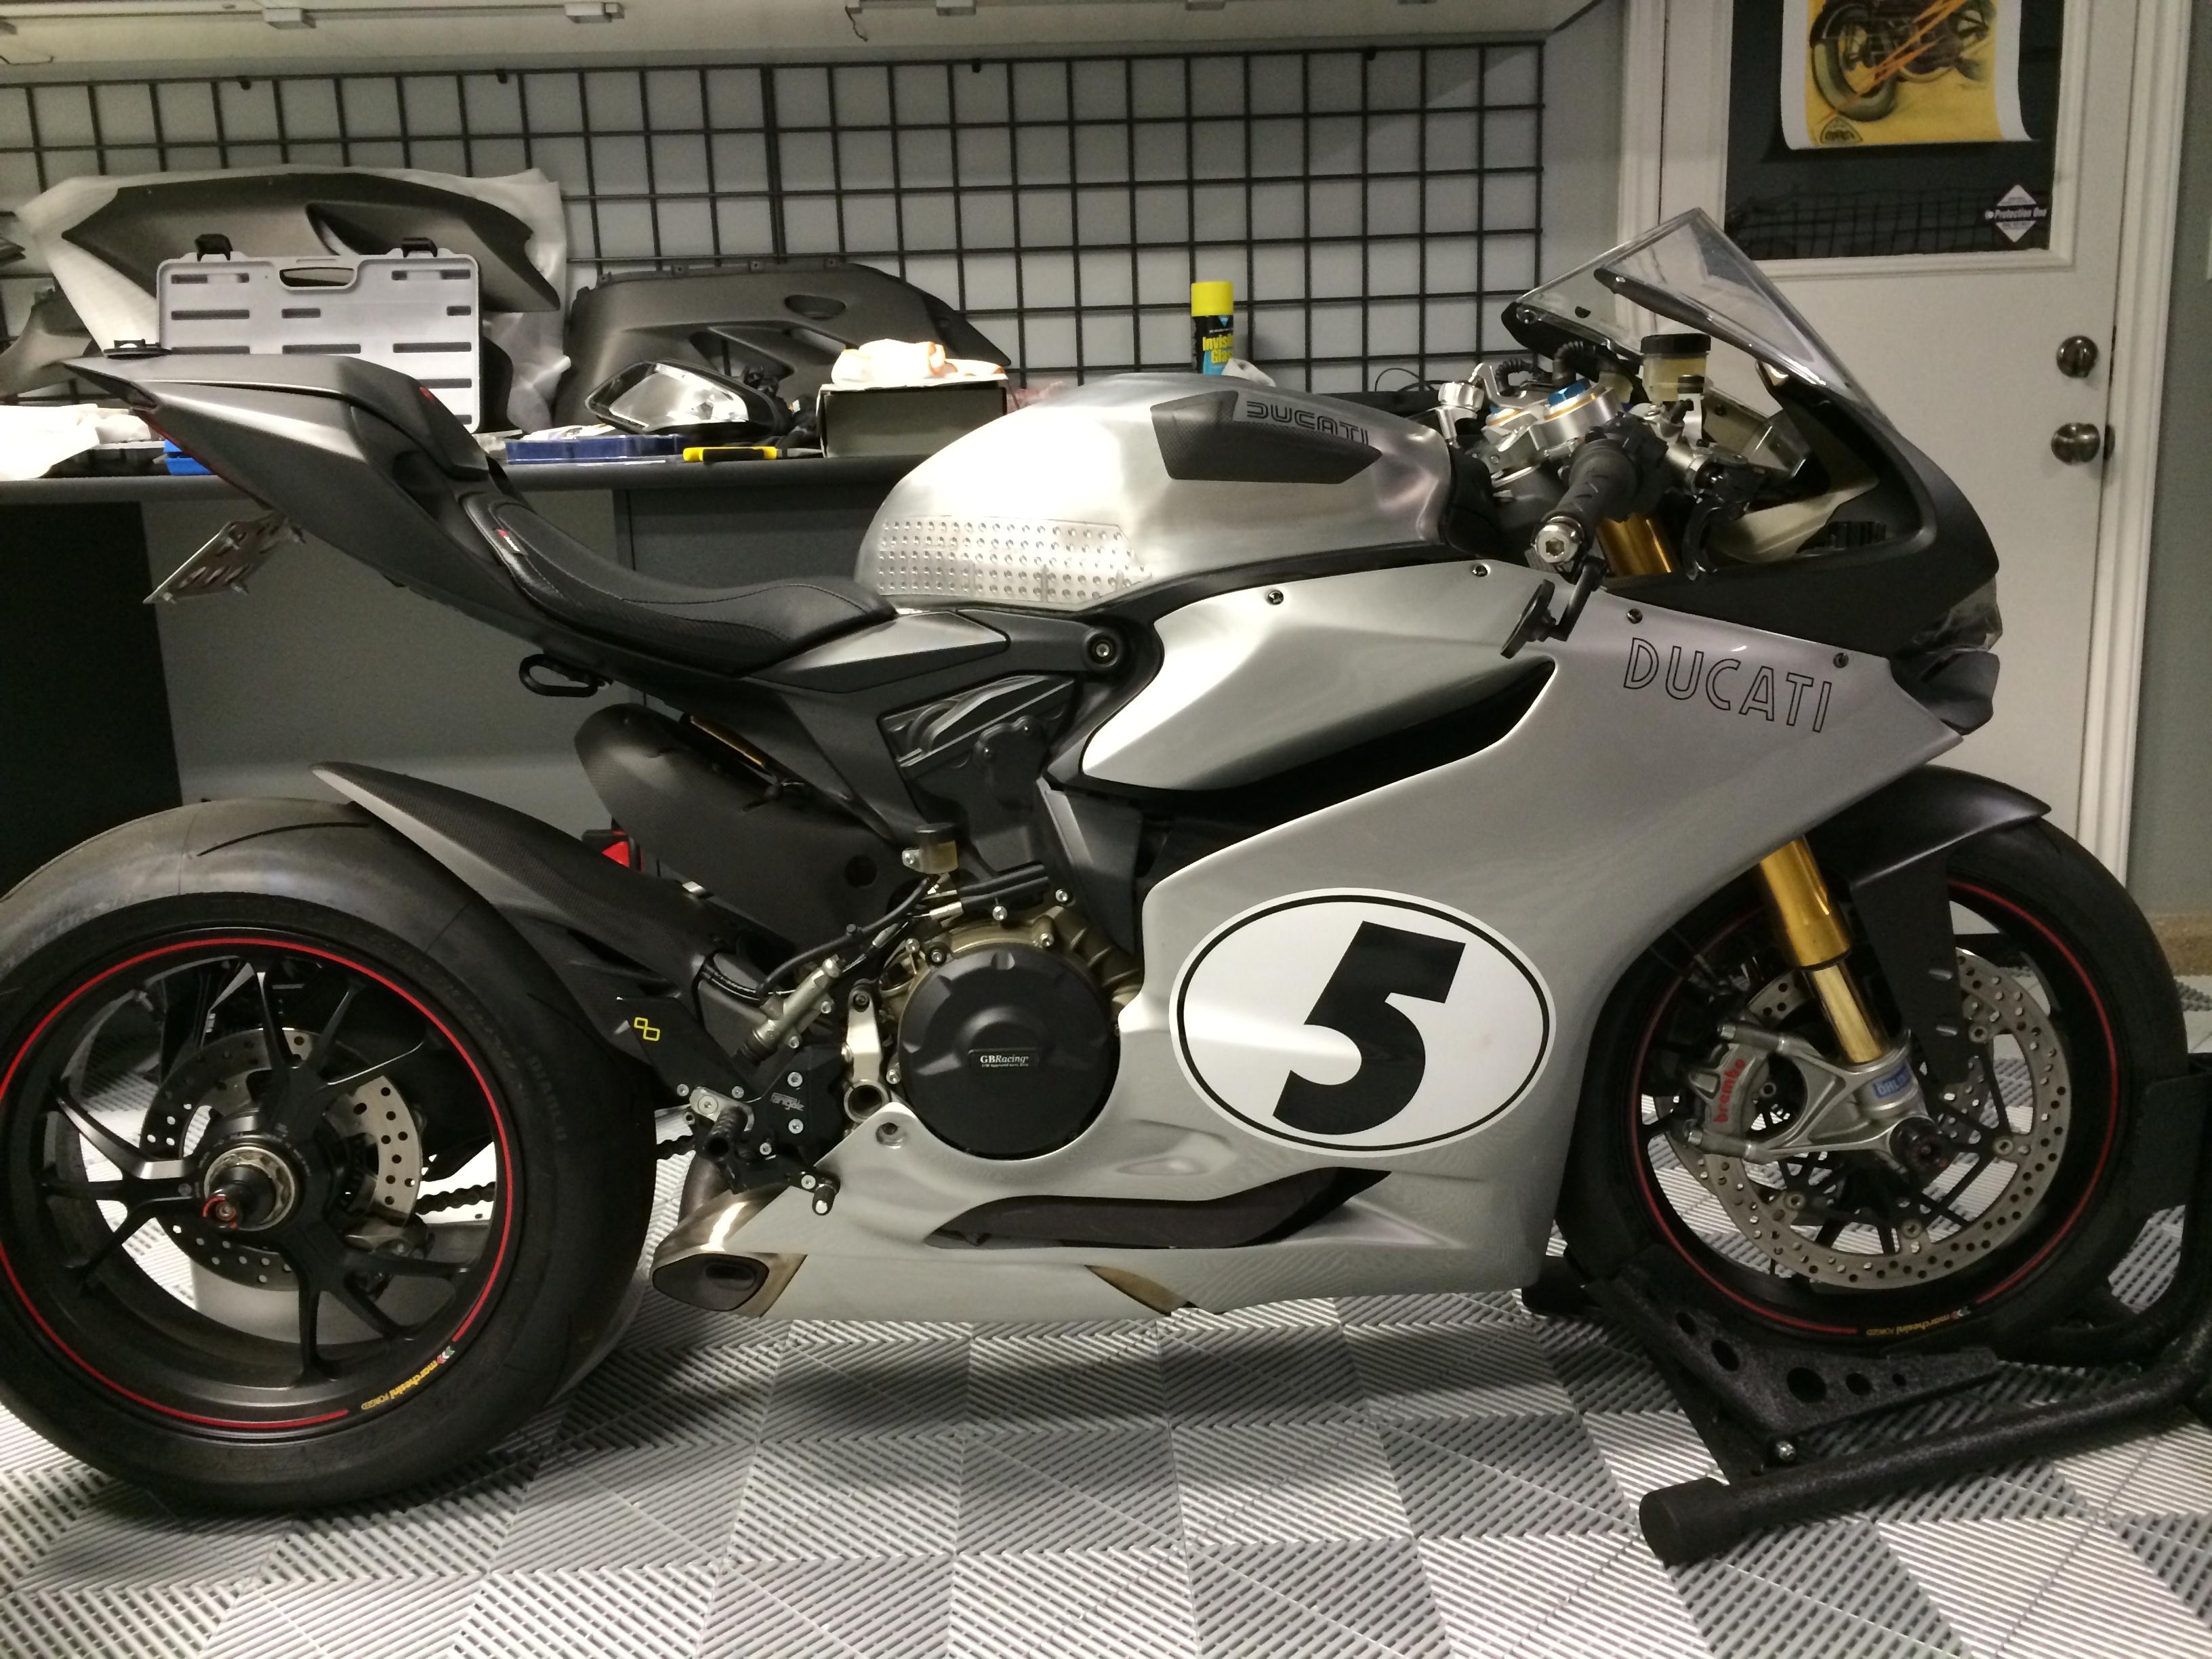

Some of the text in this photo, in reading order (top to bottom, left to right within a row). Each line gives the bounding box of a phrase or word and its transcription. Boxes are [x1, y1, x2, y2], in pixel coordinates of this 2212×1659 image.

[1246, 400, 1369, 445] DUCATI
[1623, 636, 1832, 733] DUCATI
[1272, 920, 1467, 1135] 5
[1713, 1059, 1746, 1123] brembo
[1896, 1313, 1950, 1335] marchesini
[389, 1359, 438, 1399] marchesini
